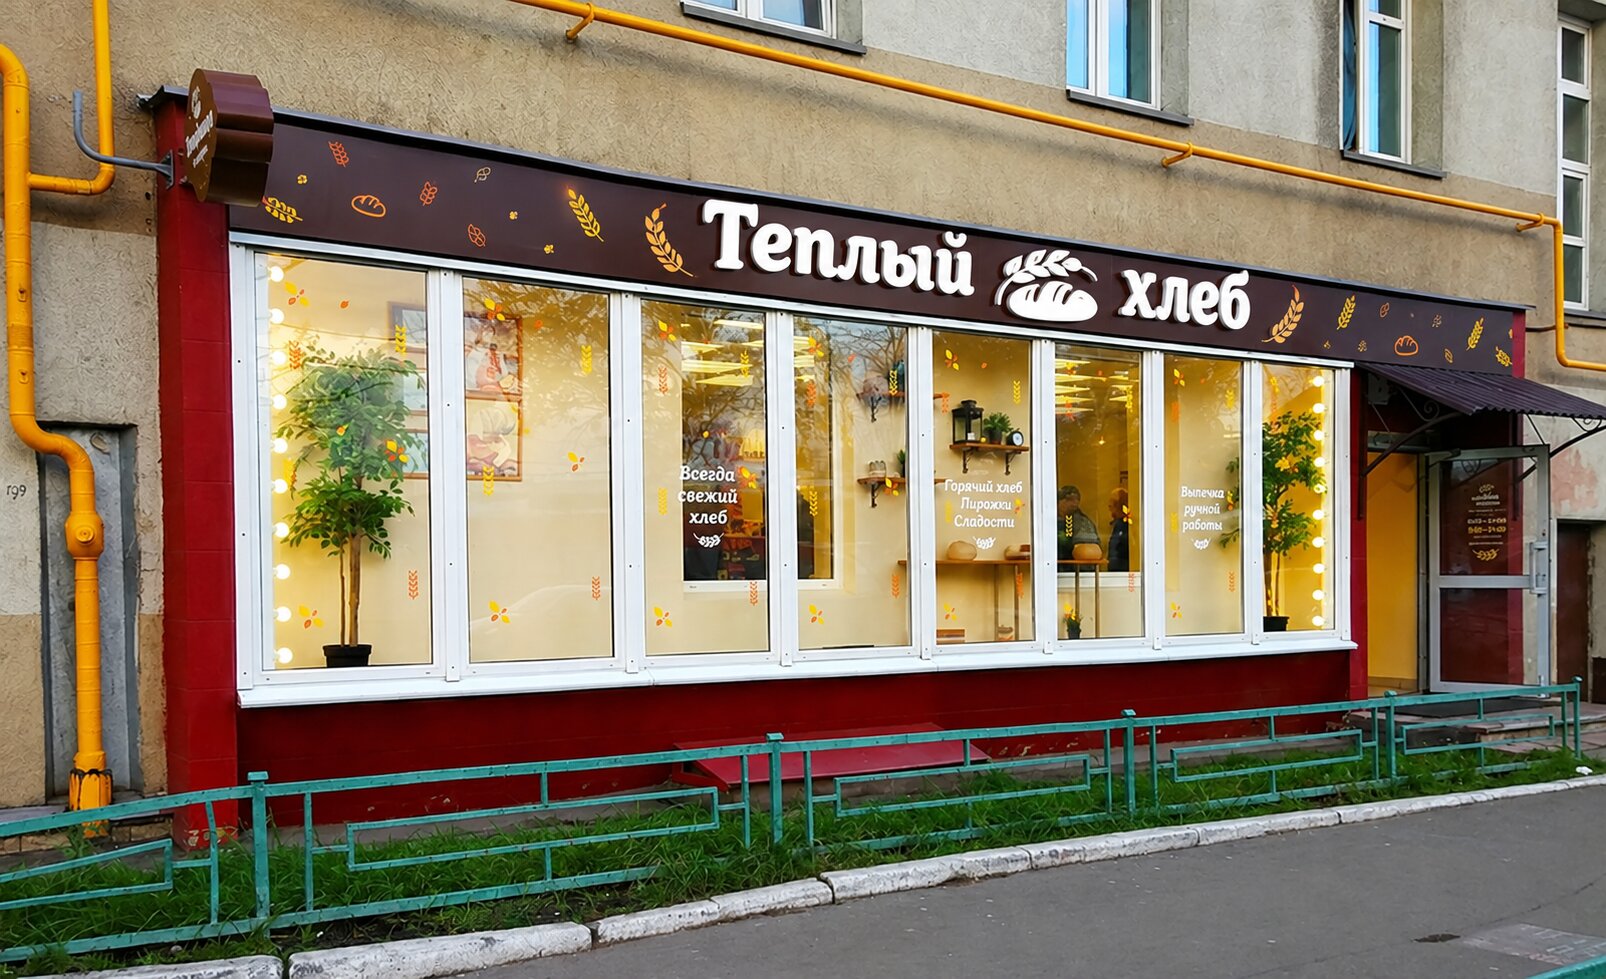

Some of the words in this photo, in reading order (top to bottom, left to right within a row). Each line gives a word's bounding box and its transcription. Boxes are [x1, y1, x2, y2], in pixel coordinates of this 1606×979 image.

[702, 198, 976, 298] Теплый
[1116, 269, 1252, 331] хлеб
[679, 465, 736, 482] Всегда
[944, 478, 993, 495] Горячий
[996, 481, 1023, 493] хлеб
[1181, 486, 1225, 499] Выпечка
[677, 488, 738, 504] свежий
[960, 497, 1012, 513] Пирожки
[1184, 503, 1220, 518] ручной
[689, 509, 728, 524] хлеб
[954, 514, 1015, 528] Сладости
[1182, 518, 1223, 533] работы
